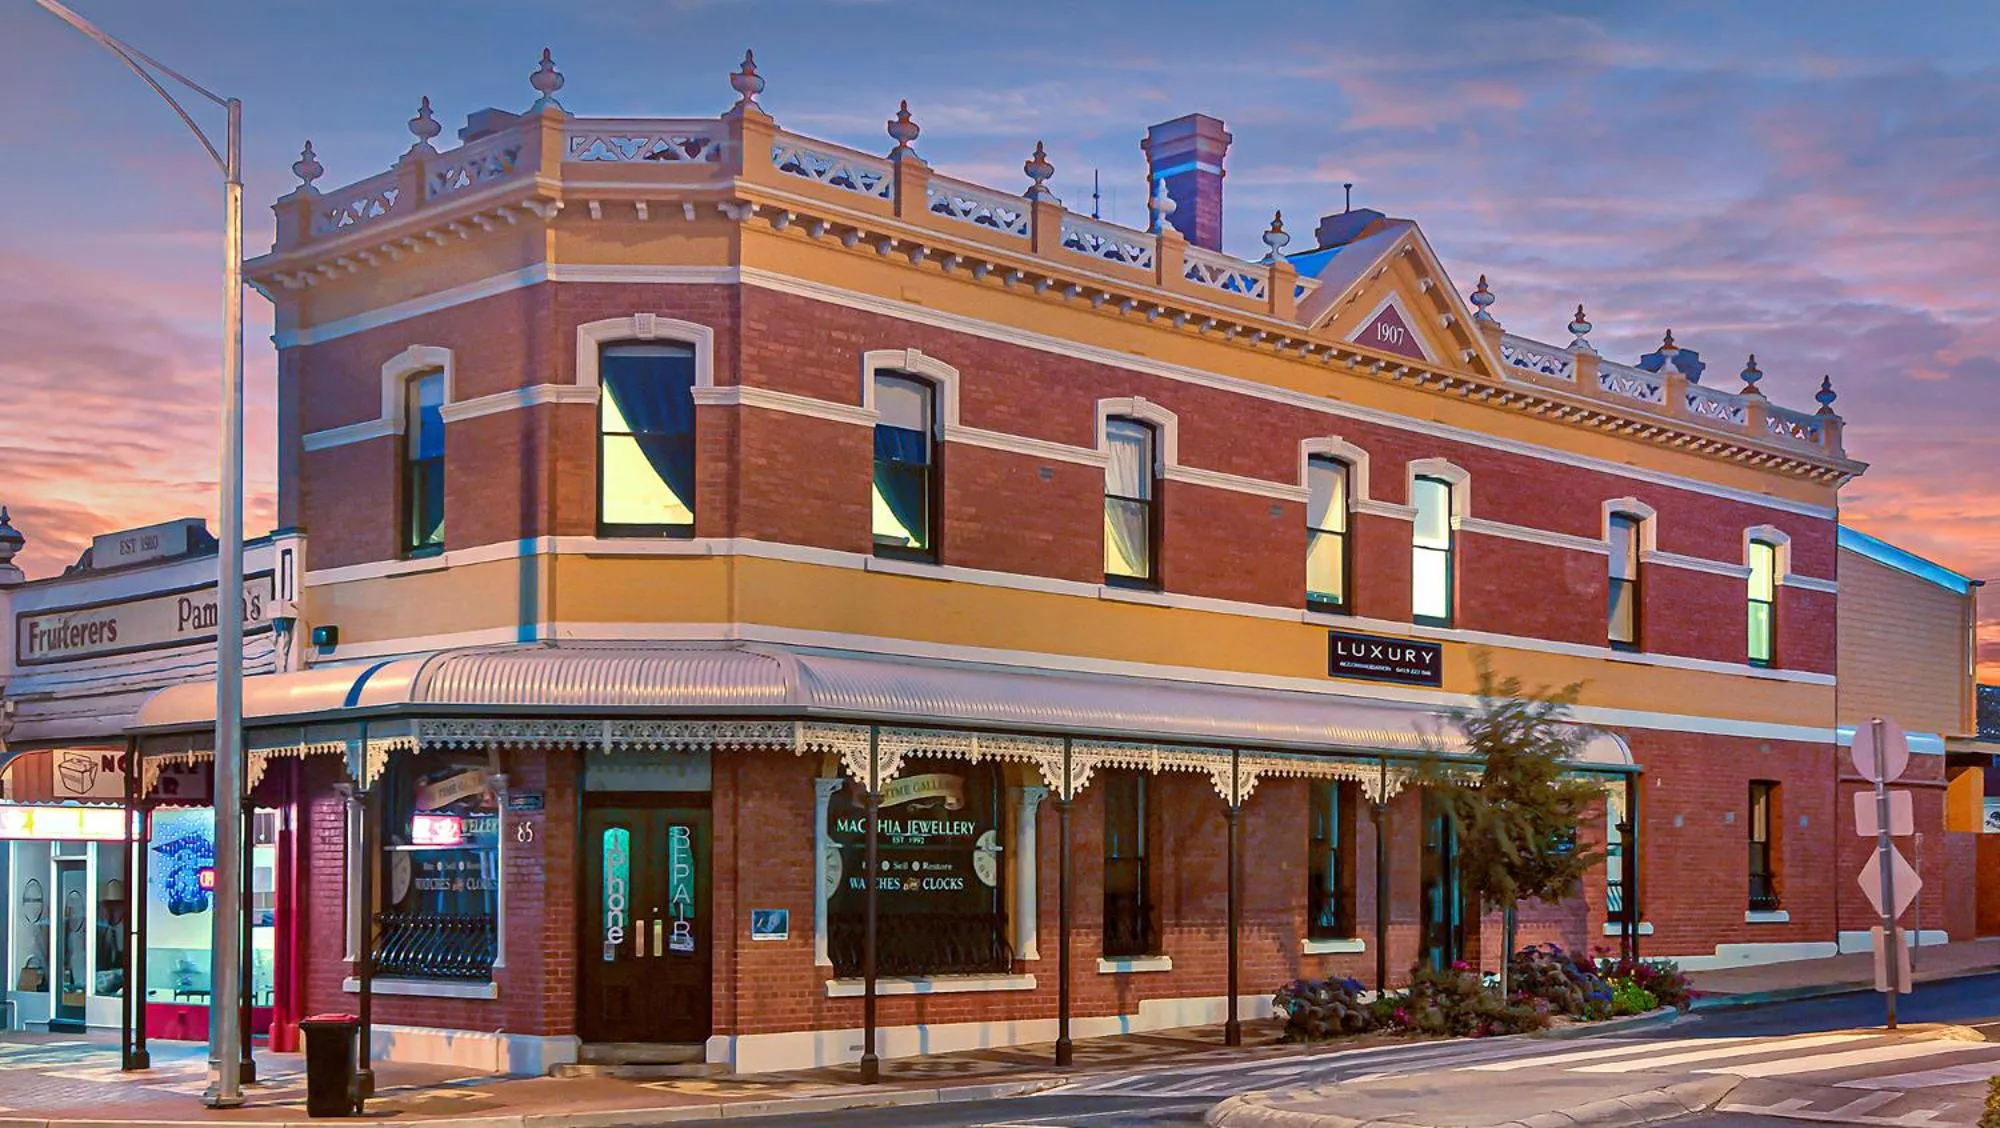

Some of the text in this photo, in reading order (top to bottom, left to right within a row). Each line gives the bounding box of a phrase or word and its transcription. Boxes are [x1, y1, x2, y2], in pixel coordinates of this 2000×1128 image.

[1377, 322, 1404, 346] 1907
[120, 538, 136, 555] EST
[29, 618, 117, 654] Fruiterers
[1337, 641, 1433, 664] LUXURY
[837, 818, 975, 835] MACHIA JEWELLERY
[849, 878, 900, 890] WAHES
[923, 878, 964, 890] CLOCKS
